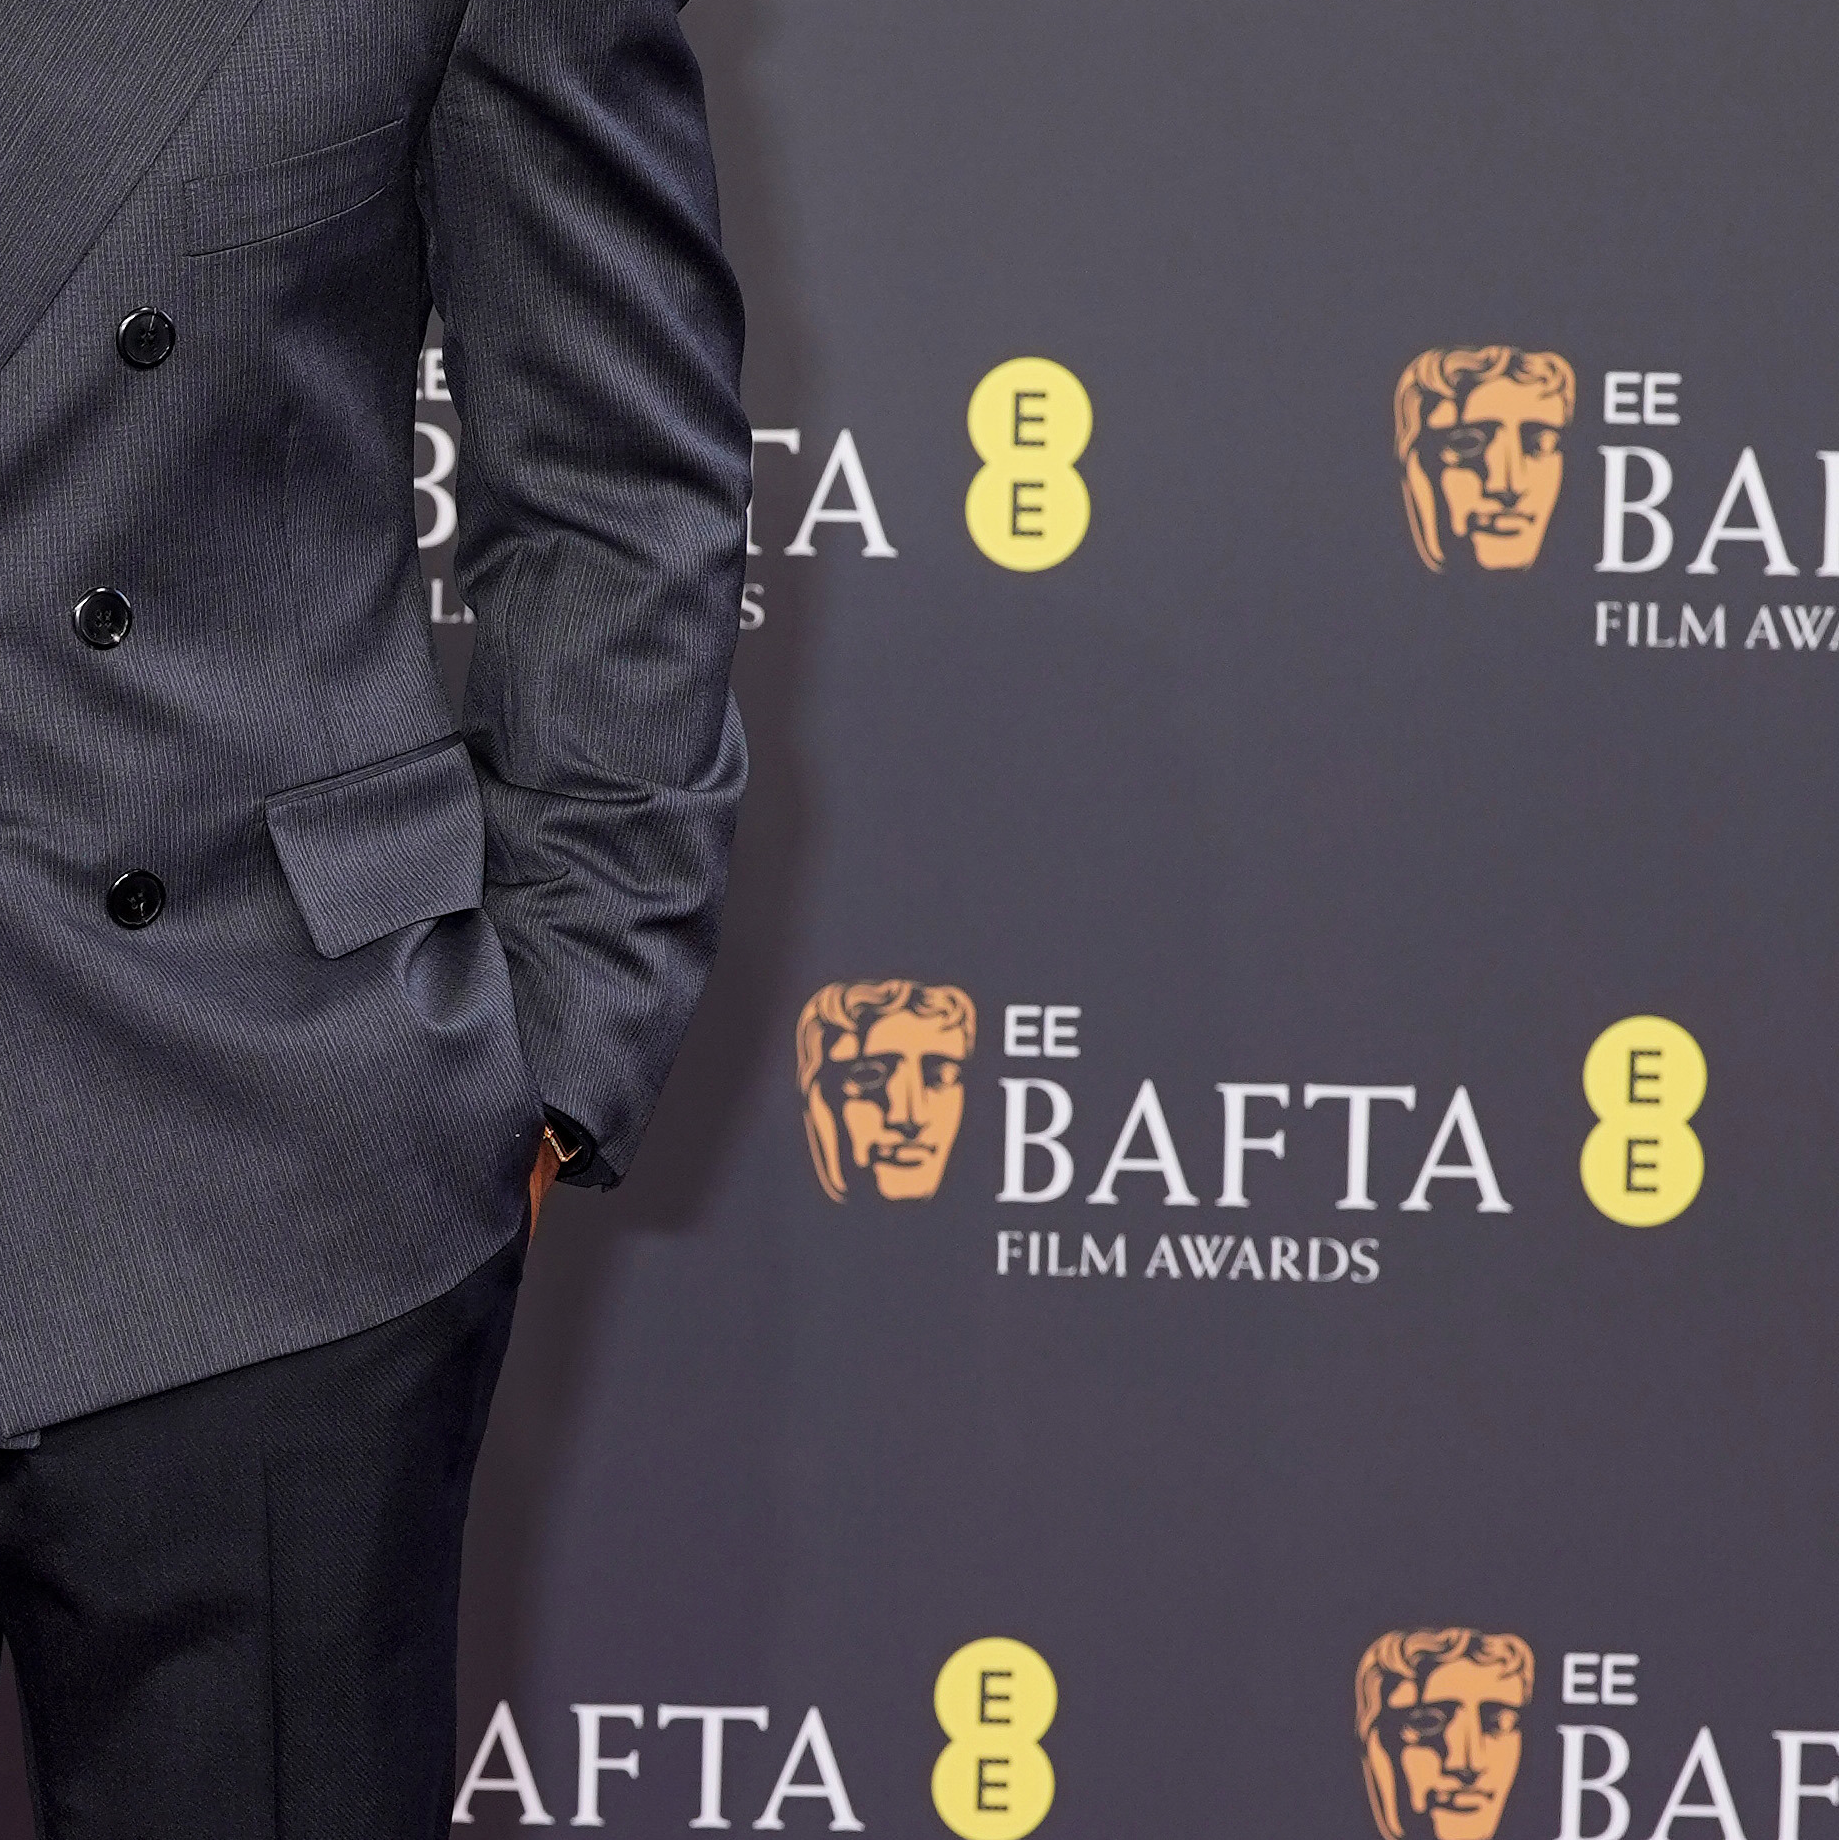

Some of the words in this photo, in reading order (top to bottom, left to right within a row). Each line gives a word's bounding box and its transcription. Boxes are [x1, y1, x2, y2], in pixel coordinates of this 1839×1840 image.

[1604, 371, 1682, 425] EE
[1596, 601, 1725, 648] FILM
[1004, 1005, 1081, 1058] EE
[996, 1078, 1513, 1213] BAFTA
[997, 1231, 1126, 1277] FILM
[1145, 1235, 1379, 1283] AWARDS
[1562, 1653, 1639, 1705] EE
[452, 1701, 865, 1831] AFTA
